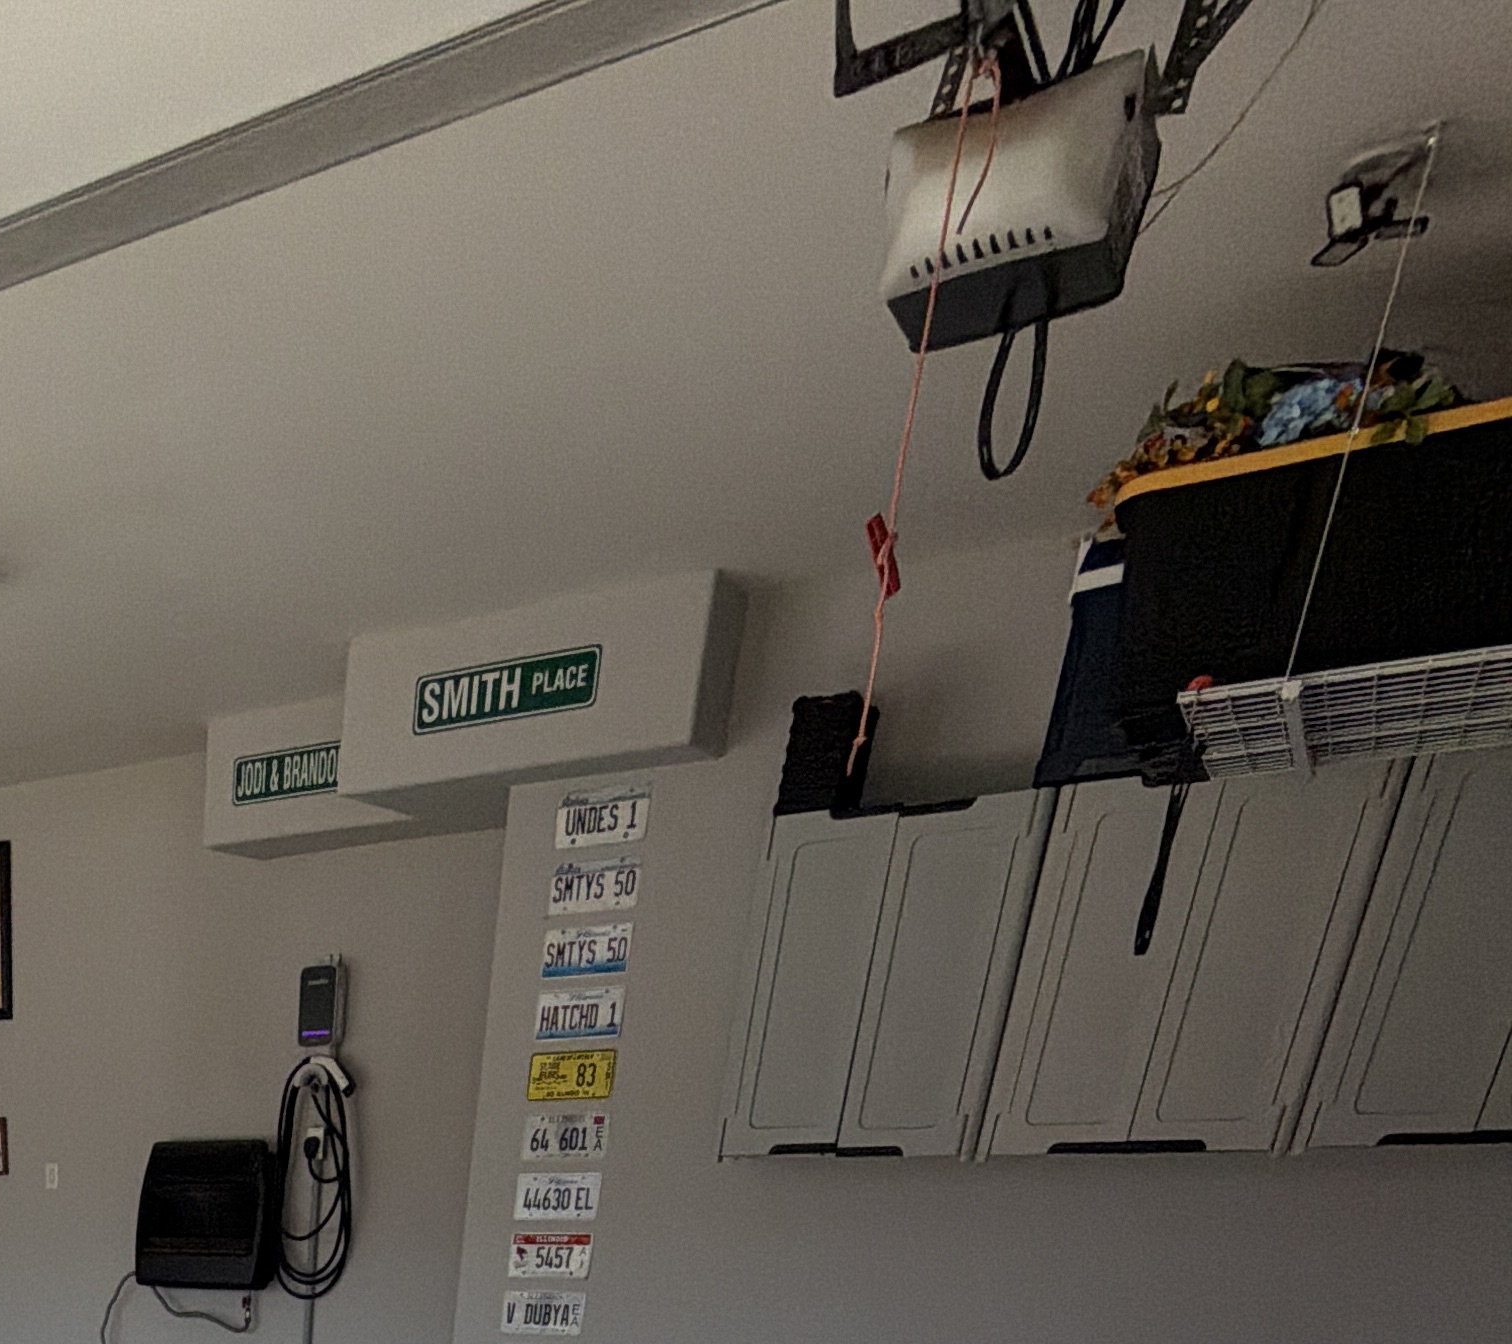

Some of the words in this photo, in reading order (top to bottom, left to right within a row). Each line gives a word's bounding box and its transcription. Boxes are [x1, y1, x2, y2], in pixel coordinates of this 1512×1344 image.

[420, 667, 522, 724] SMITH
[531, 663, 591, 695] PLACE
[237, 761, 266, 798] JODI
[269, 759, 279, 793] &
[282, 748, 338, 790] BRANDO
[564, 804, 619, 836] UNDES
[626, 801, 638, 829] 1
[552, 871, 605, 904] SMTYS
[614, 868, 636, 898] 50
[545, 939, 598, 968] SMTYS
[539, 1003, 599, 1032] HATCHD
[606, 1001, 617, 1028] 1
[575, 1062, 597, 1088] 83
[530, 1128, 550, 1152] 64
[558, 1127, 588, 1151] 601
[522, 1187, 571, 1212] 44630
[574, 1187, 594, 1211] EL
[535, 1246, 575, 1270] 5457
[506, 1302, 516, 1325] V
[523, 1303, 569, 1327] DUBYA
